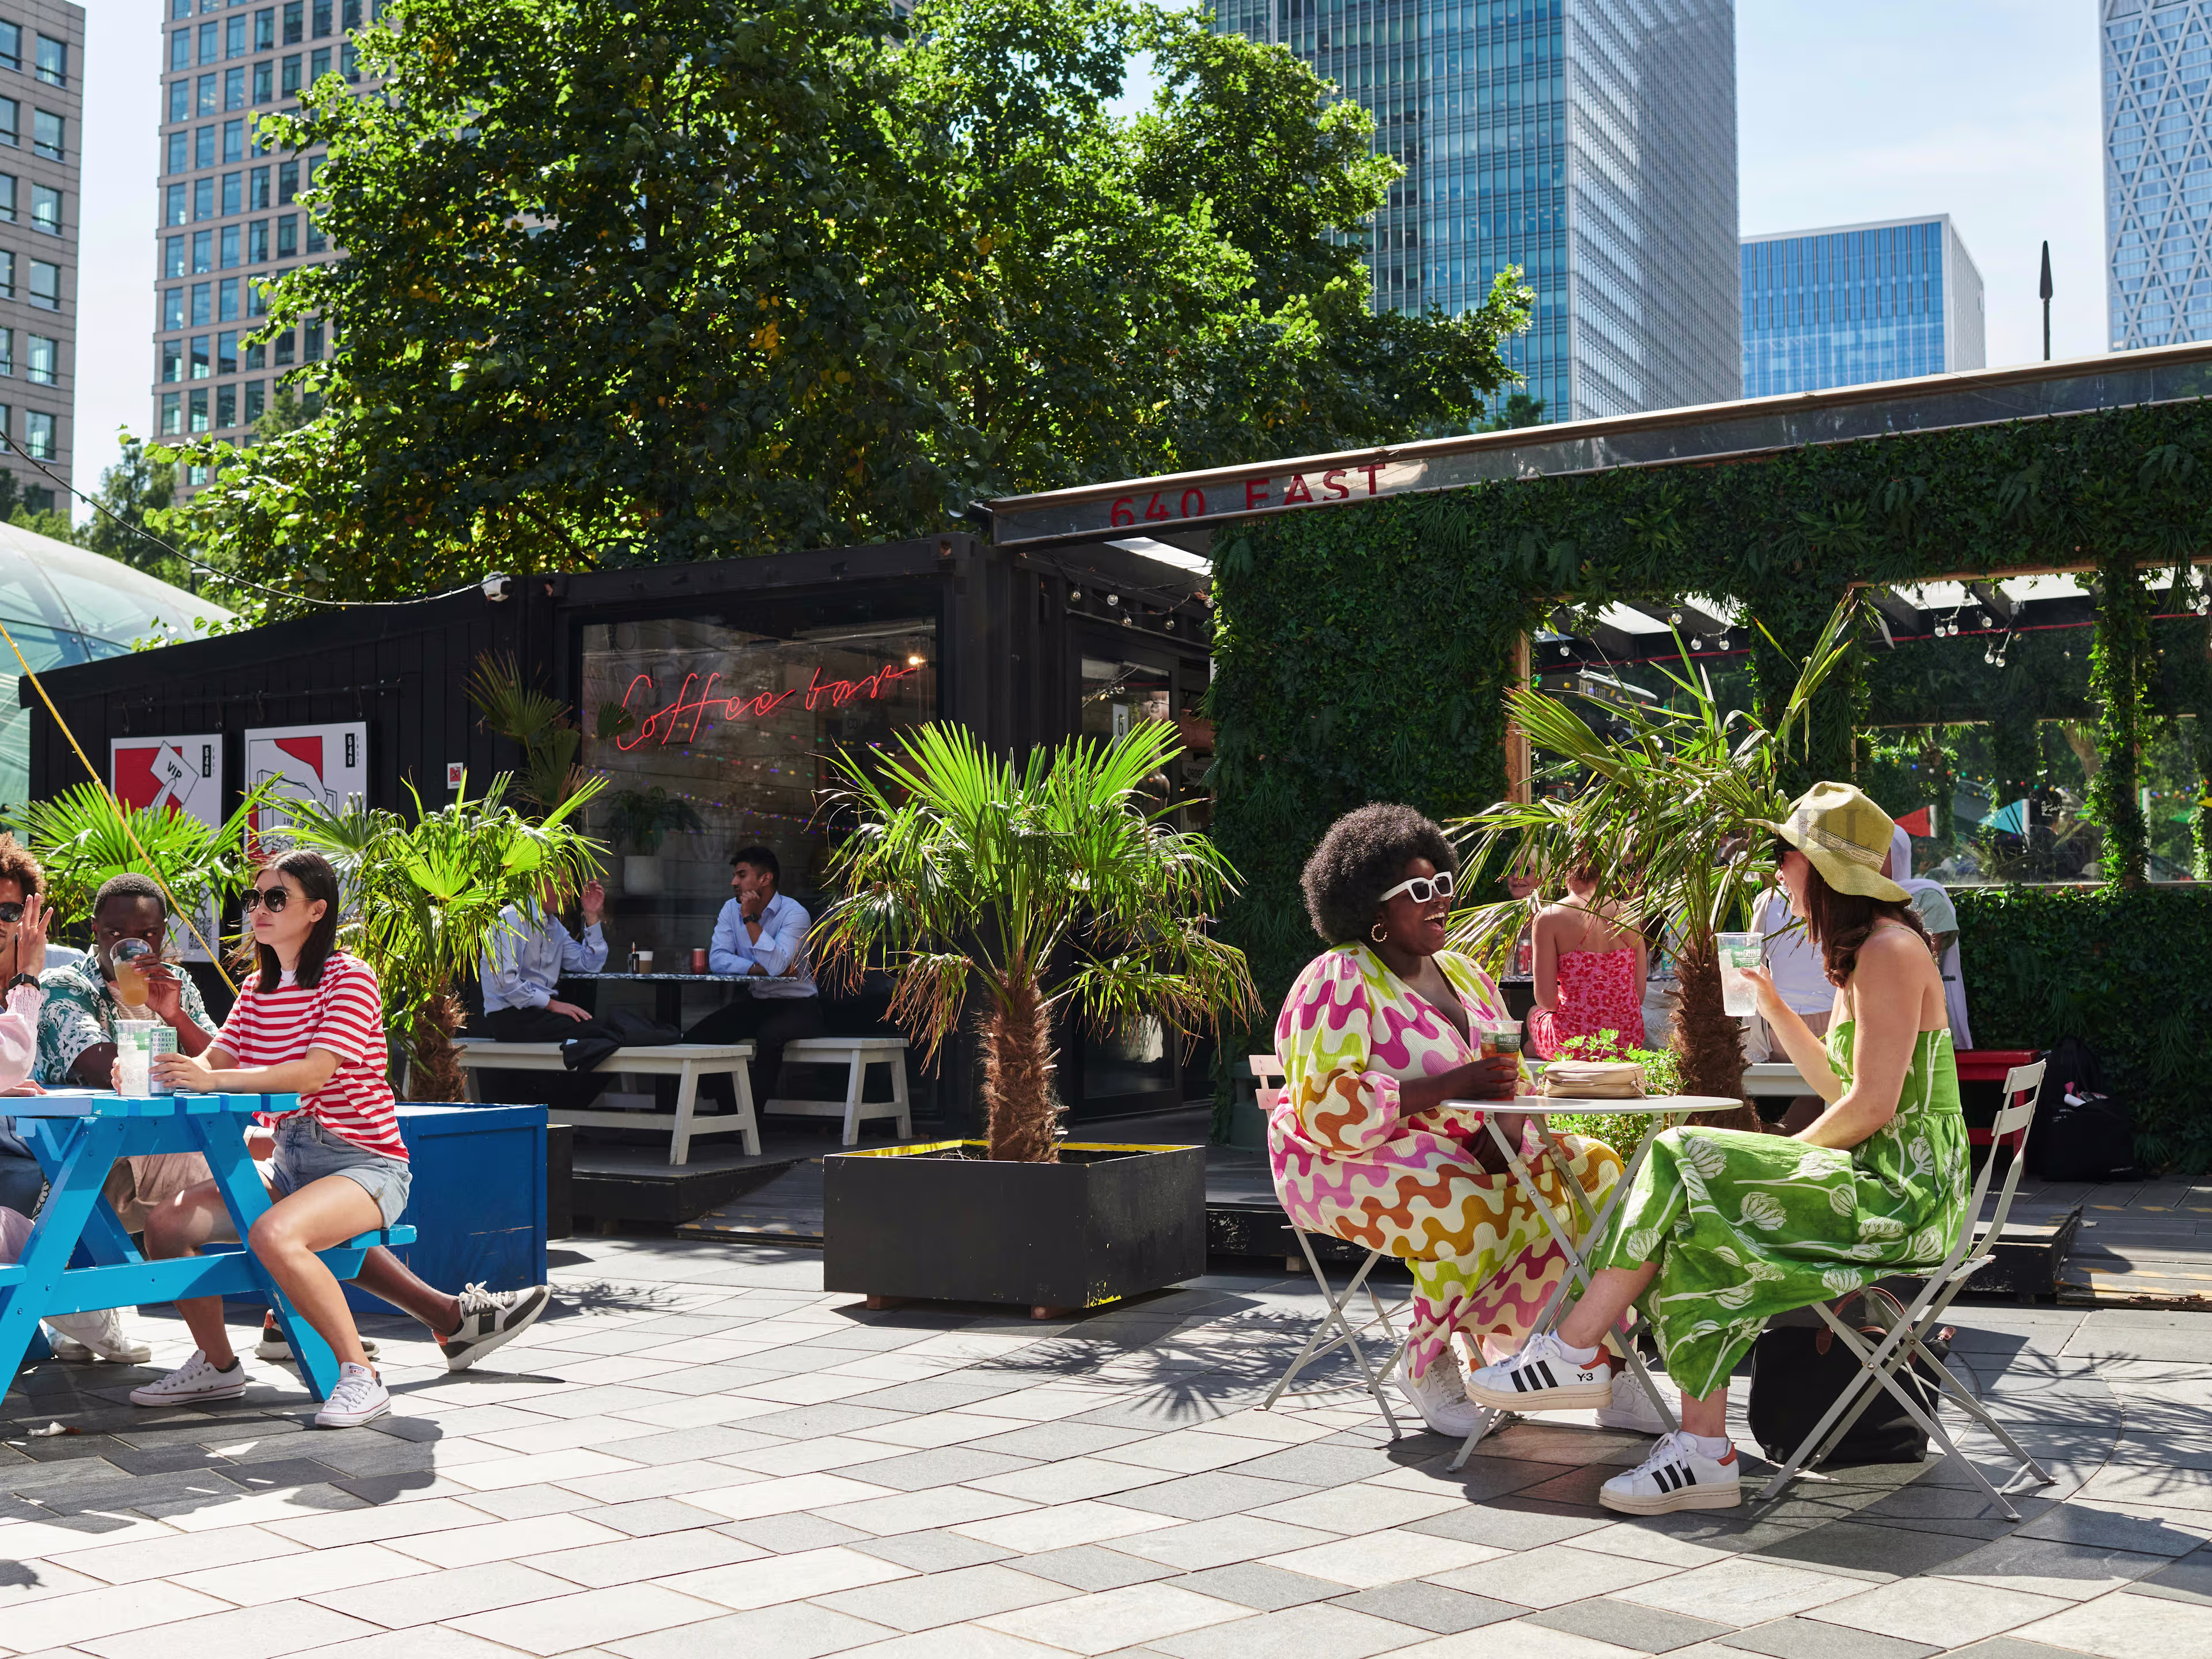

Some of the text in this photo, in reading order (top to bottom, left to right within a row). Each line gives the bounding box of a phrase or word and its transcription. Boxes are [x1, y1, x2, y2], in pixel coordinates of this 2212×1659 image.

[1111, 463, 1386, 528] 640 EAST
[617, 665, 918, 751] Coffee bar
[167, 761, 182, 779] VIP
[1577, 1373, 1593, 1381] Y-3
